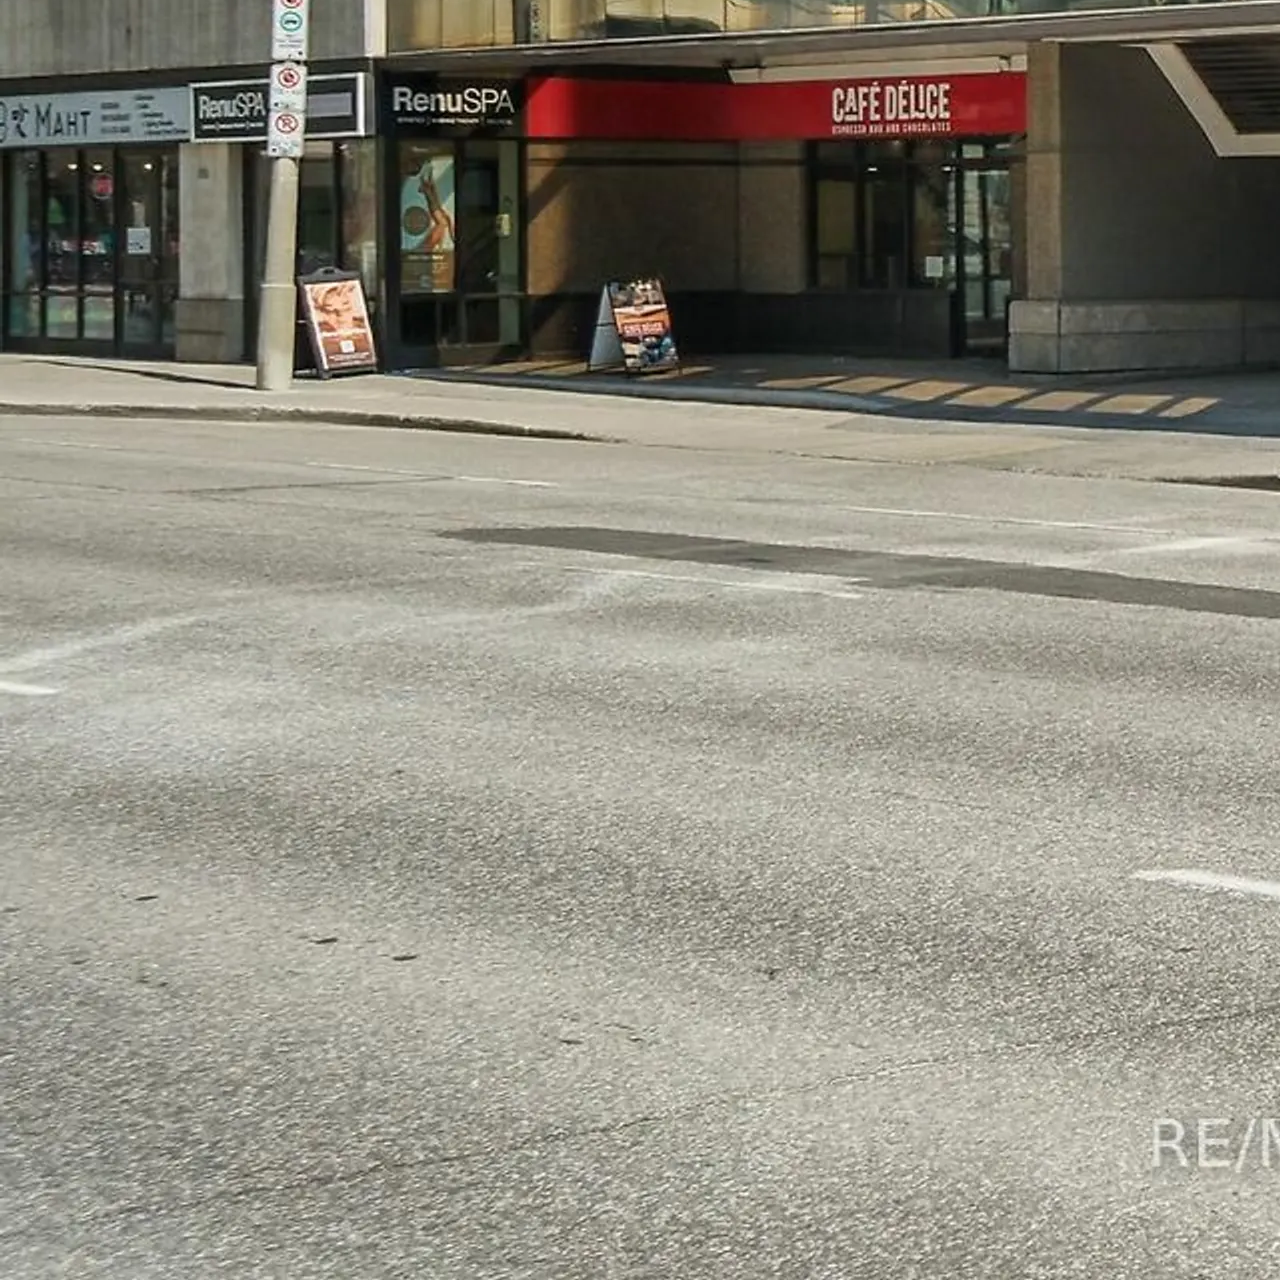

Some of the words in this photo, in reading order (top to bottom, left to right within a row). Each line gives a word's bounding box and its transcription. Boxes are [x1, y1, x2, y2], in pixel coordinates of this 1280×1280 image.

[199, 92, 267, 120] RenuSPA
[393, 86, 515, 113] RenuSPA
[832, 81, 880, 122] CAFÉ
[884, 80, 951, 121] DÉLICE
